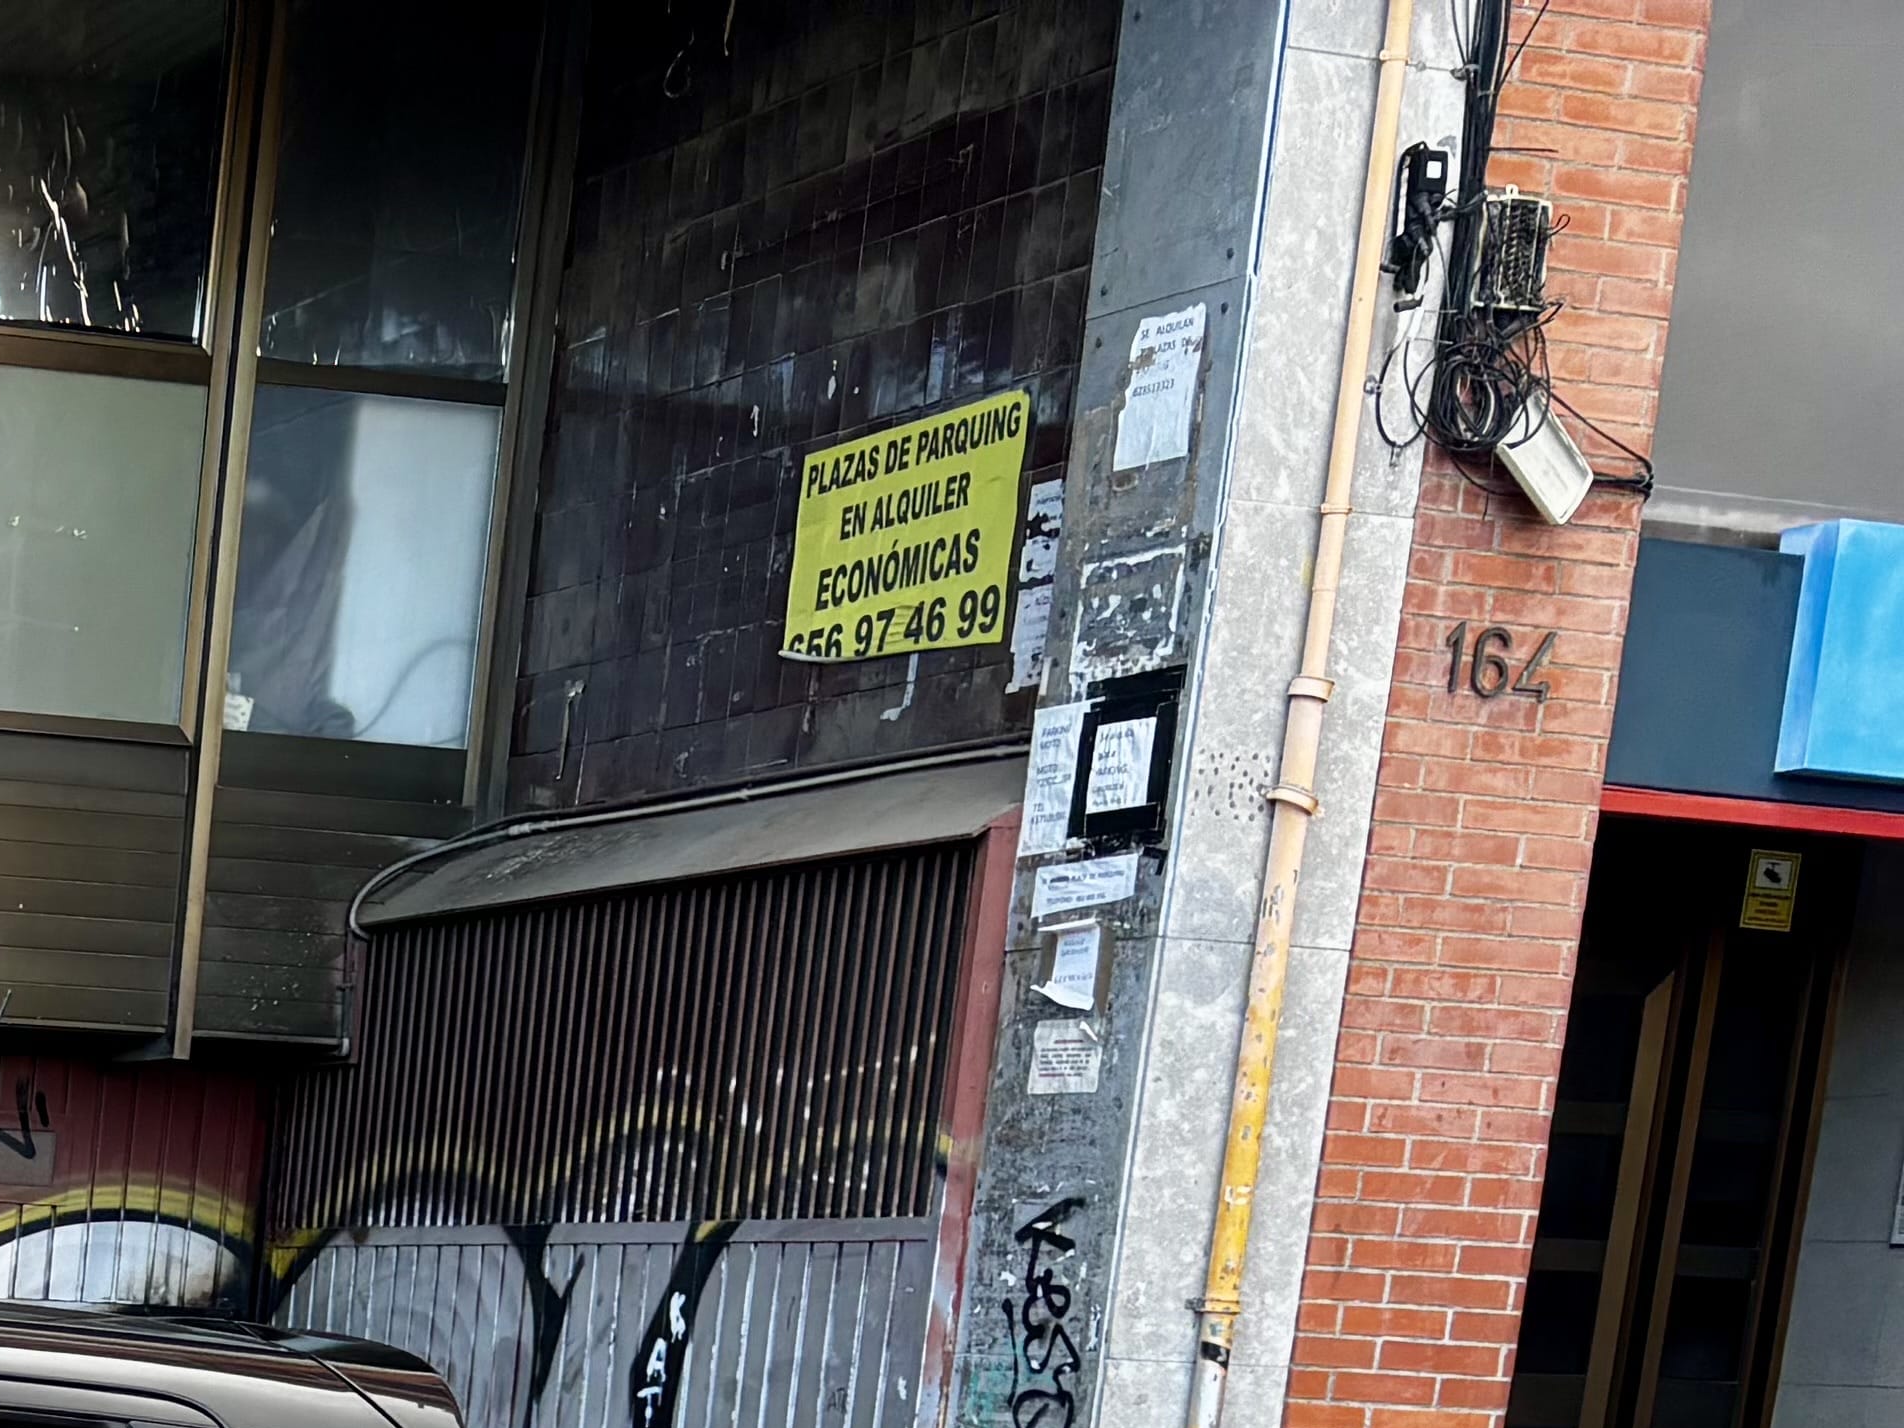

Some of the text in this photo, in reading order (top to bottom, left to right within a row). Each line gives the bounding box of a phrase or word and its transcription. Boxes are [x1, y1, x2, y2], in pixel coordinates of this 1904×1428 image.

[806, 401, 1022, 499] PLAZAS DE PARQUING
[839, 471, 972, 541] EN ALQUILER
[814, 527, 981, 612] ECONÓMICAS
[854, 608, 896, 657] 97
[903, 596, 947, 645] 46
[957, 583, 1001, 638] 99
[1446, 621, 1558, 703] 164
